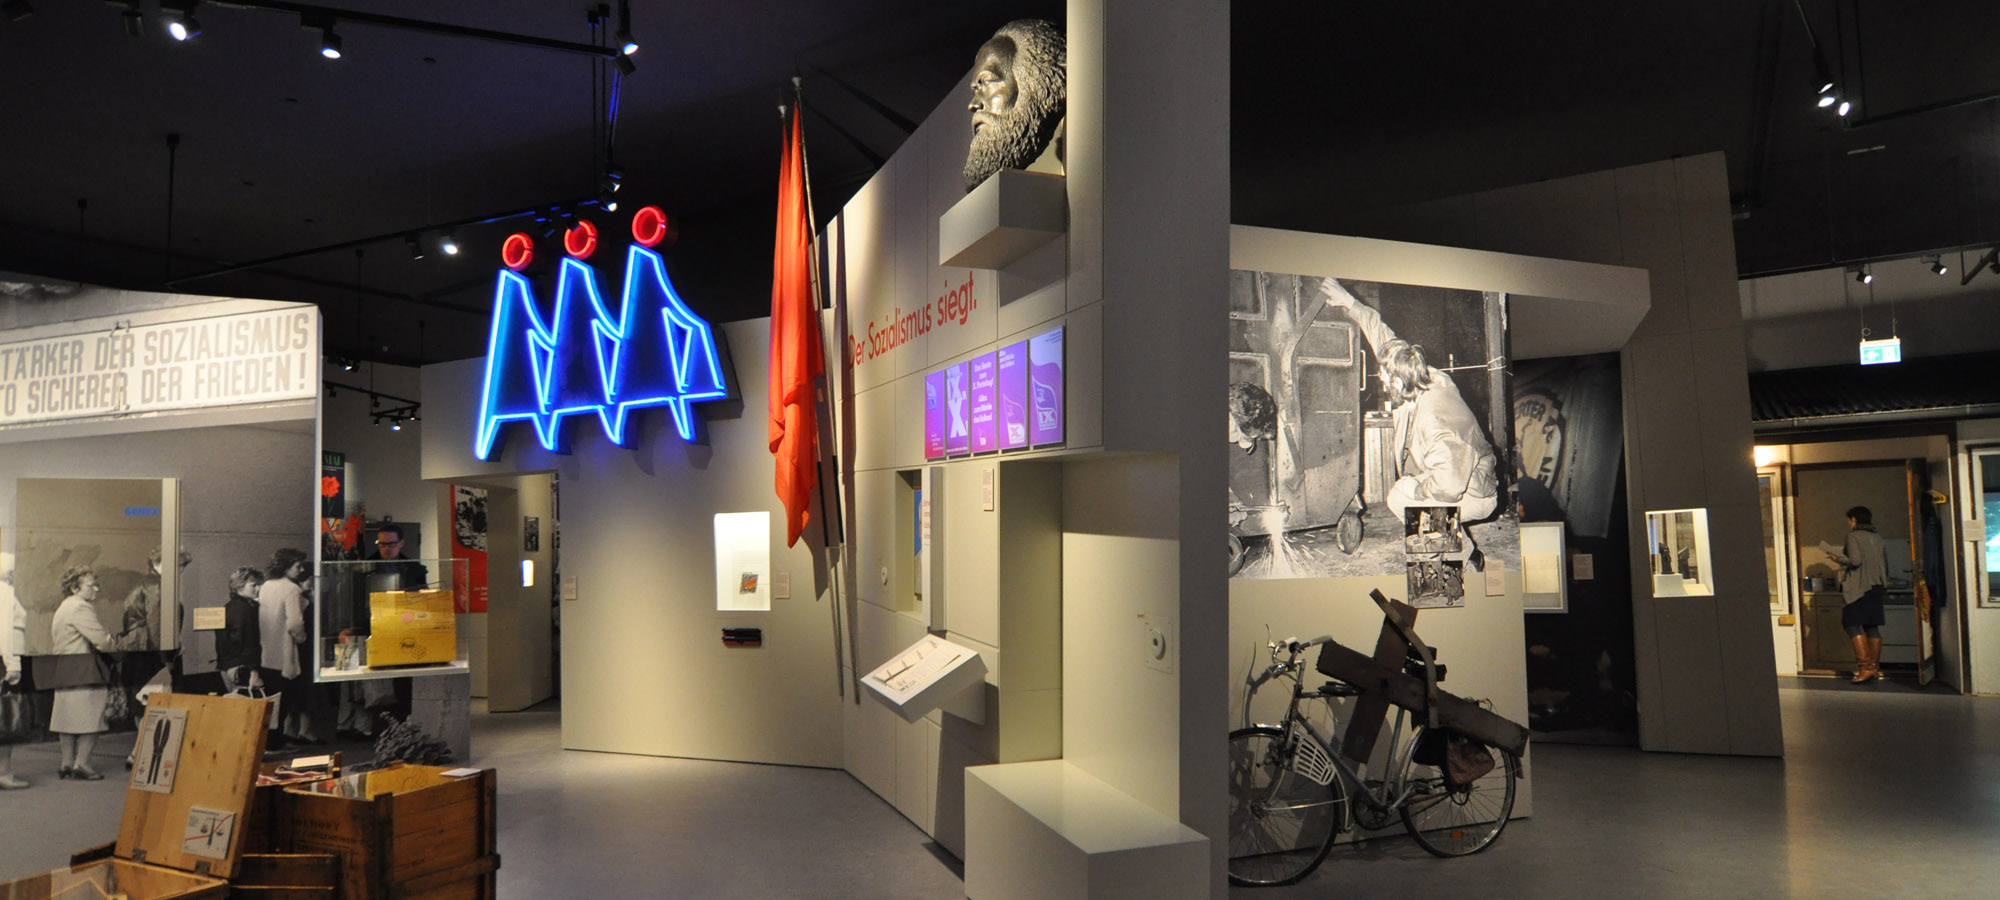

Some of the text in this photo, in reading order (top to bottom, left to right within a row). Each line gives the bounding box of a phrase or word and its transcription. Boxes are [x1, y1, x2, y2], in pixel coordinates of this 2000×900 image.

[95, 333, 135, 371] DER
[143, 313, 309, 366] SOZIALISMUS
[849, 270, 977, 369] Der Sozialismus siegt.
[27, 371, 129, 414] SICHERER
[141, 366, 182, 404] DER
